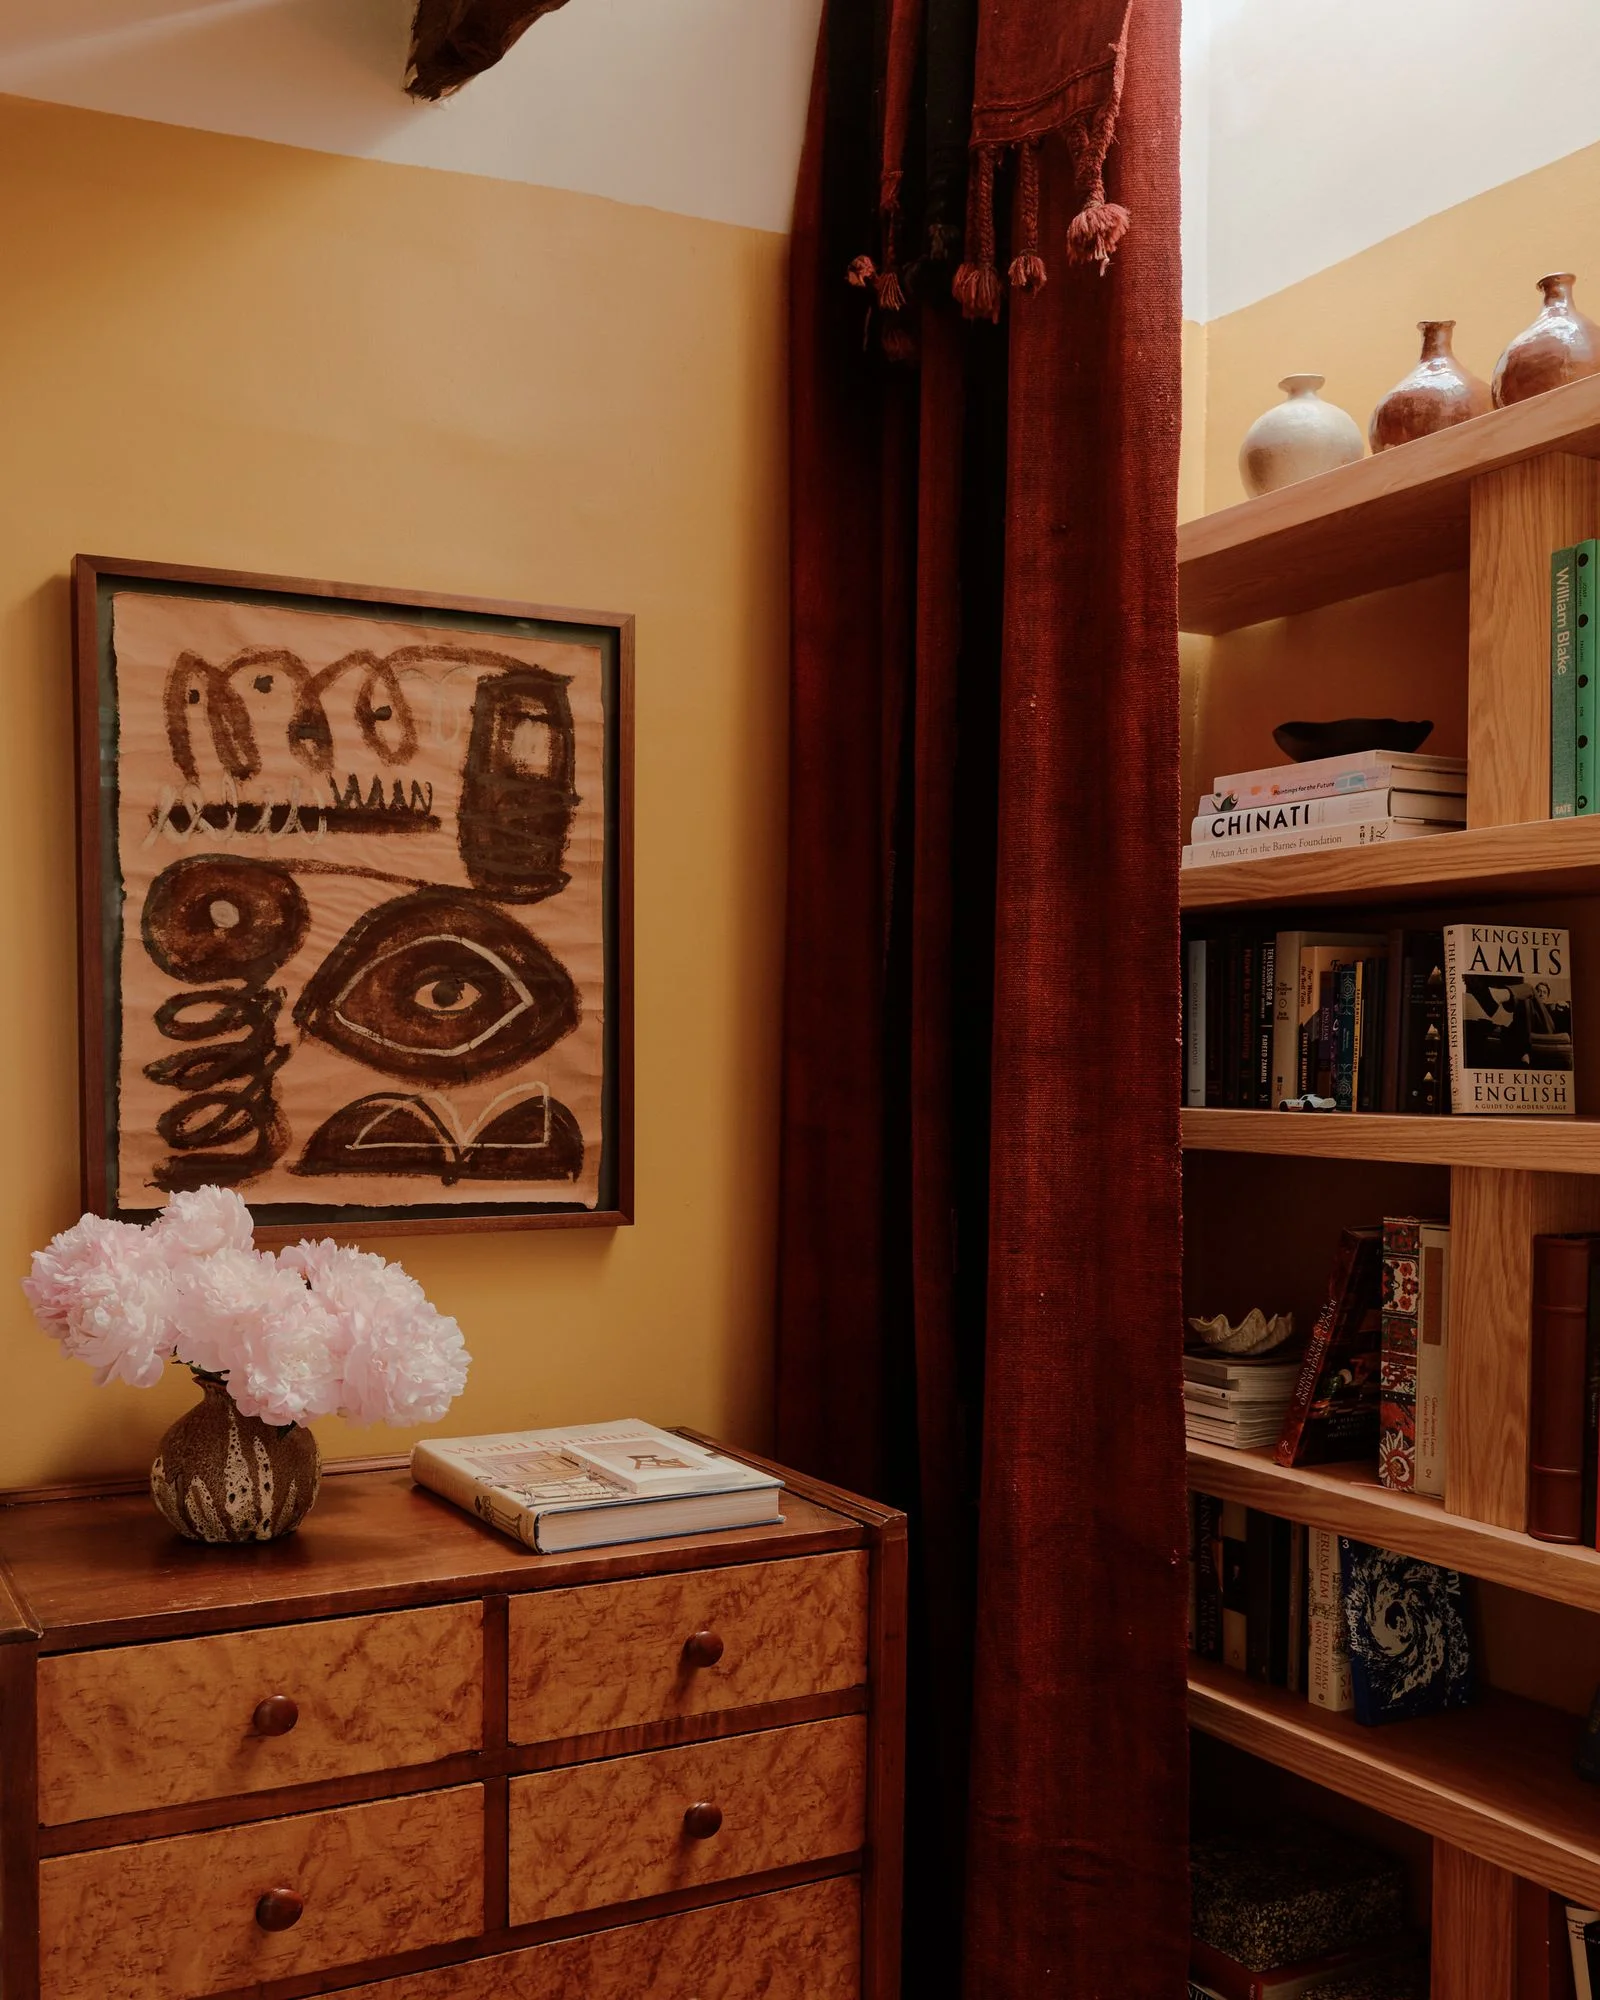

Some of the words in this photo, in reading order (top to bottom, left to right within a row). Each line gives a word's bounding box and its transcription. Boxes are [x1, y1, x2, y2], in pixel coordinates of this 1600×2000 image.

[1555, 567, 1569, 629] William
[1557, 633, 1570, 676] Blake
[1273, 787, 1298, 796] Paintings
[1316, 781, 1335, 789] Future
[1211, 804, 1310, 838] CHINATI
[1555, 804, 1572, 816] TATE
[1209, 848, 1235, 859] African
[1236, 846, 1249, 856] Art
[1250, 845, 1258, 854] in
[1259, 843, 1271, 853] the
[1272, 840, 1297, 851] Barnes
[1298, 834, 1342, 847] Foundation
[1471, 928, 1561, 946] KINGSLEY
[1243, 948, 1252, 975] How
[1468, 944, 1562, 976] AMIS
[1242, 978, 1252, 989] to
[1449, 966, 1457, 1000] KING'S
[1242, 993, 1252, 1009] Do
[1241, 1013, 1252, 1060] Nothing
[1450, 1003, 1458, 1048] ENGLISH
[1260, 1058, 1268, 1083] ZAKARIA
[1473, 1072, 1504, 1084] THE
[1513, 1072, 1566, 1086] KING'S
[1474, 1085, 1567, 1103] ENGLISH
[1322, 1298, 1337, 1334] RENZO
[1295, 1366, 1310, 1398] VISION
[1300, 1336, 1326, 1406] MONGIARDINO
[442, 1442, 529, 1455] World
[533, 1431, 649, 1448] Furniture
[1200, 1494, 1212, 1575] KISSINGER
[1341, 1538, 1350, 1550] 3
[1319, 1531, 1330, 1599] ERUSALEM
[1322, 1620, 1330, 1656] SIMON
[1347, 1609, 1361, 1651] balcony
[1314, 1620, 1323, 1687] MONTEFIORE
[1321, 1658, 1329, 1691] SEBAG
